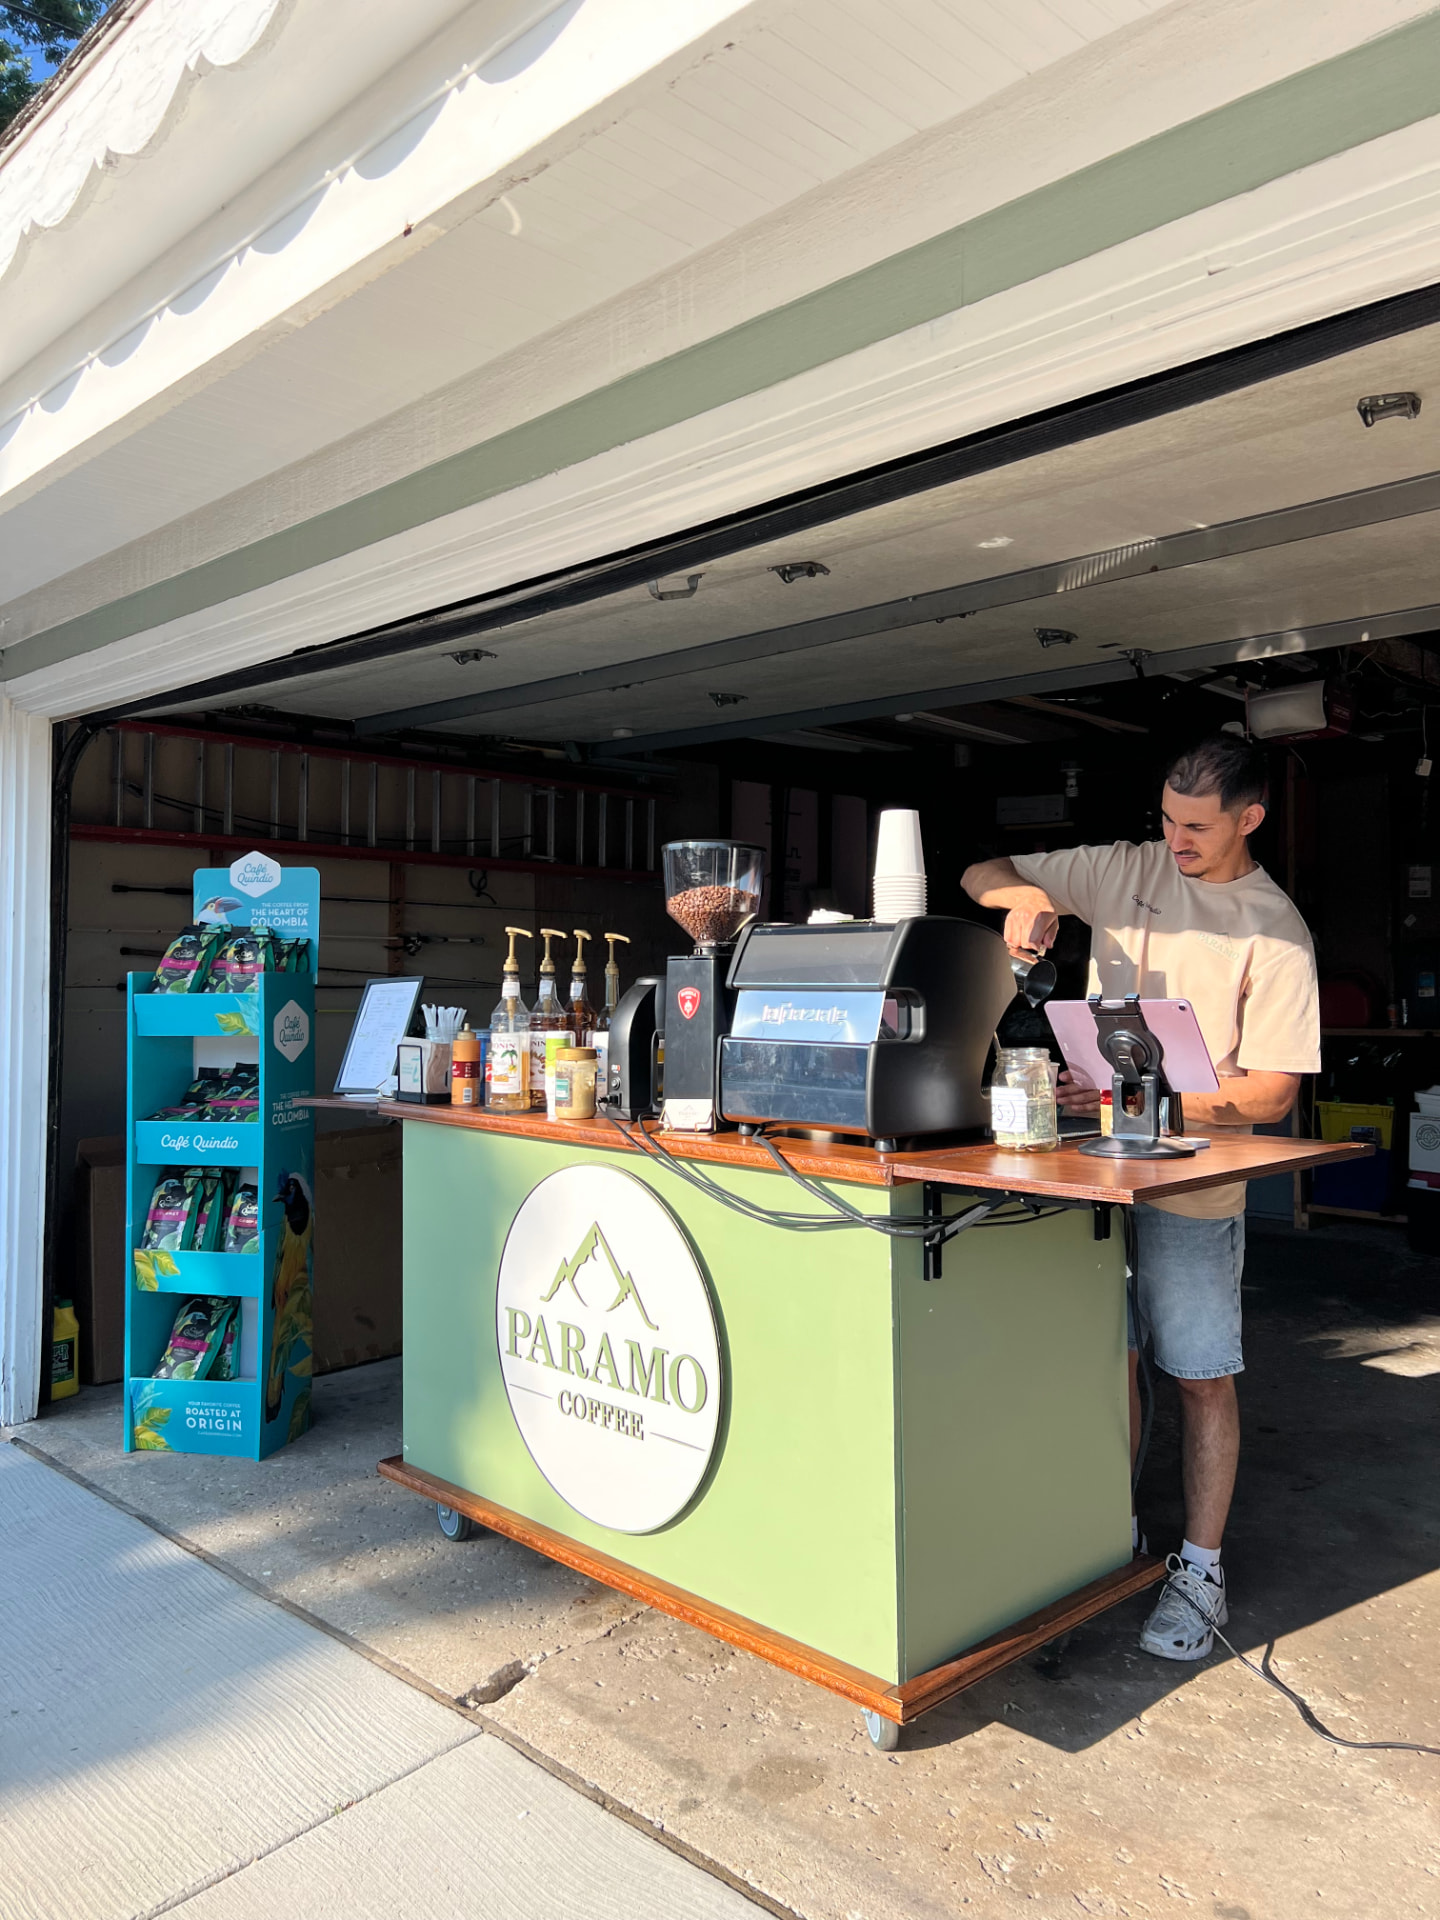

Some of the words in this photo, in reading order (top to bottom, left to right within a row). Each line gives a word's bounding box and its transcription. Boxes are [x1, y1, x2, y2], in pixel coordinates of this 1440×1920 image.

[244, 863, 267, 875] Café
[296, 908, 308, 916] OF
[250, 917, 308, 927] COLOMBIA
[1197, 932, 1240, 961] PARAMO
[272, 1102, 284, 1112] THE
[272, 1109, 310, 1125] COLOMBIA
[161, 1134, 190, 1151] Café
[193, 1134, 239, 1152] Quindío
[505, 1306, 708, 1414] PARAMO
[185, 1407, 228, 1417] ROASTED
[230, 1410, 241, 1418] AT
[557, 1389, 645, 1441] COFFEE
[186, 1417, 242, 1431] ORIGIN
